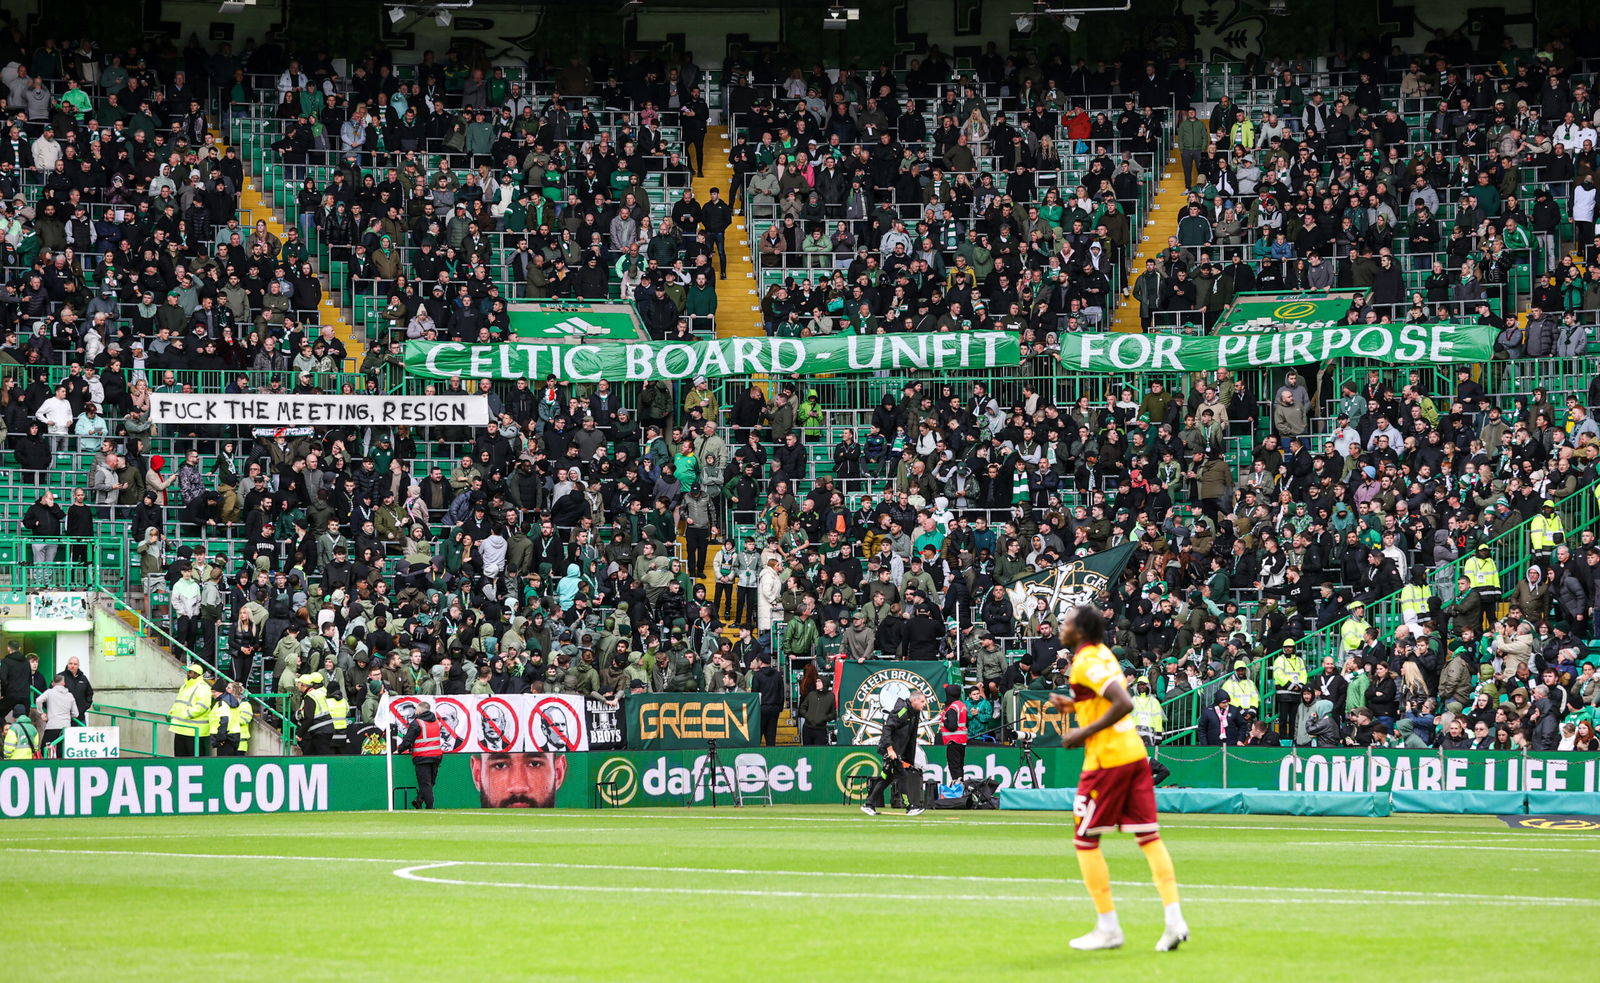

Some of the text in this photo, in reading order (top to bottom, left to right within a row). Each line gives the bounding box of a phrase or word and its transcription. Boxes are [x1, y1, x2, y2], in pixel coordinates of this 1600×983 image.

[425, 342, 602, 381] CELTIC
[626, 338, 806, 379] BOARD
[847, 331, 1008, 369] UNFIT
[1080, 325, 1456, 371] FOR PURPOSE
[159, 400, 467, 423] FUCK THE MEETING, RESIGN
[857, 670, 937, 703] GREEN BRIGADE
[79, 732, 105, 743] Exit
[590, 729, 622, 743] BHOYS
[639, 700, 750, 742] GREEN
[66, 747, 119, 758] Gate 14
[1279, 754, 1469, 792] COMPARE
[0, 764, 329, 818] OMPARE.COM
